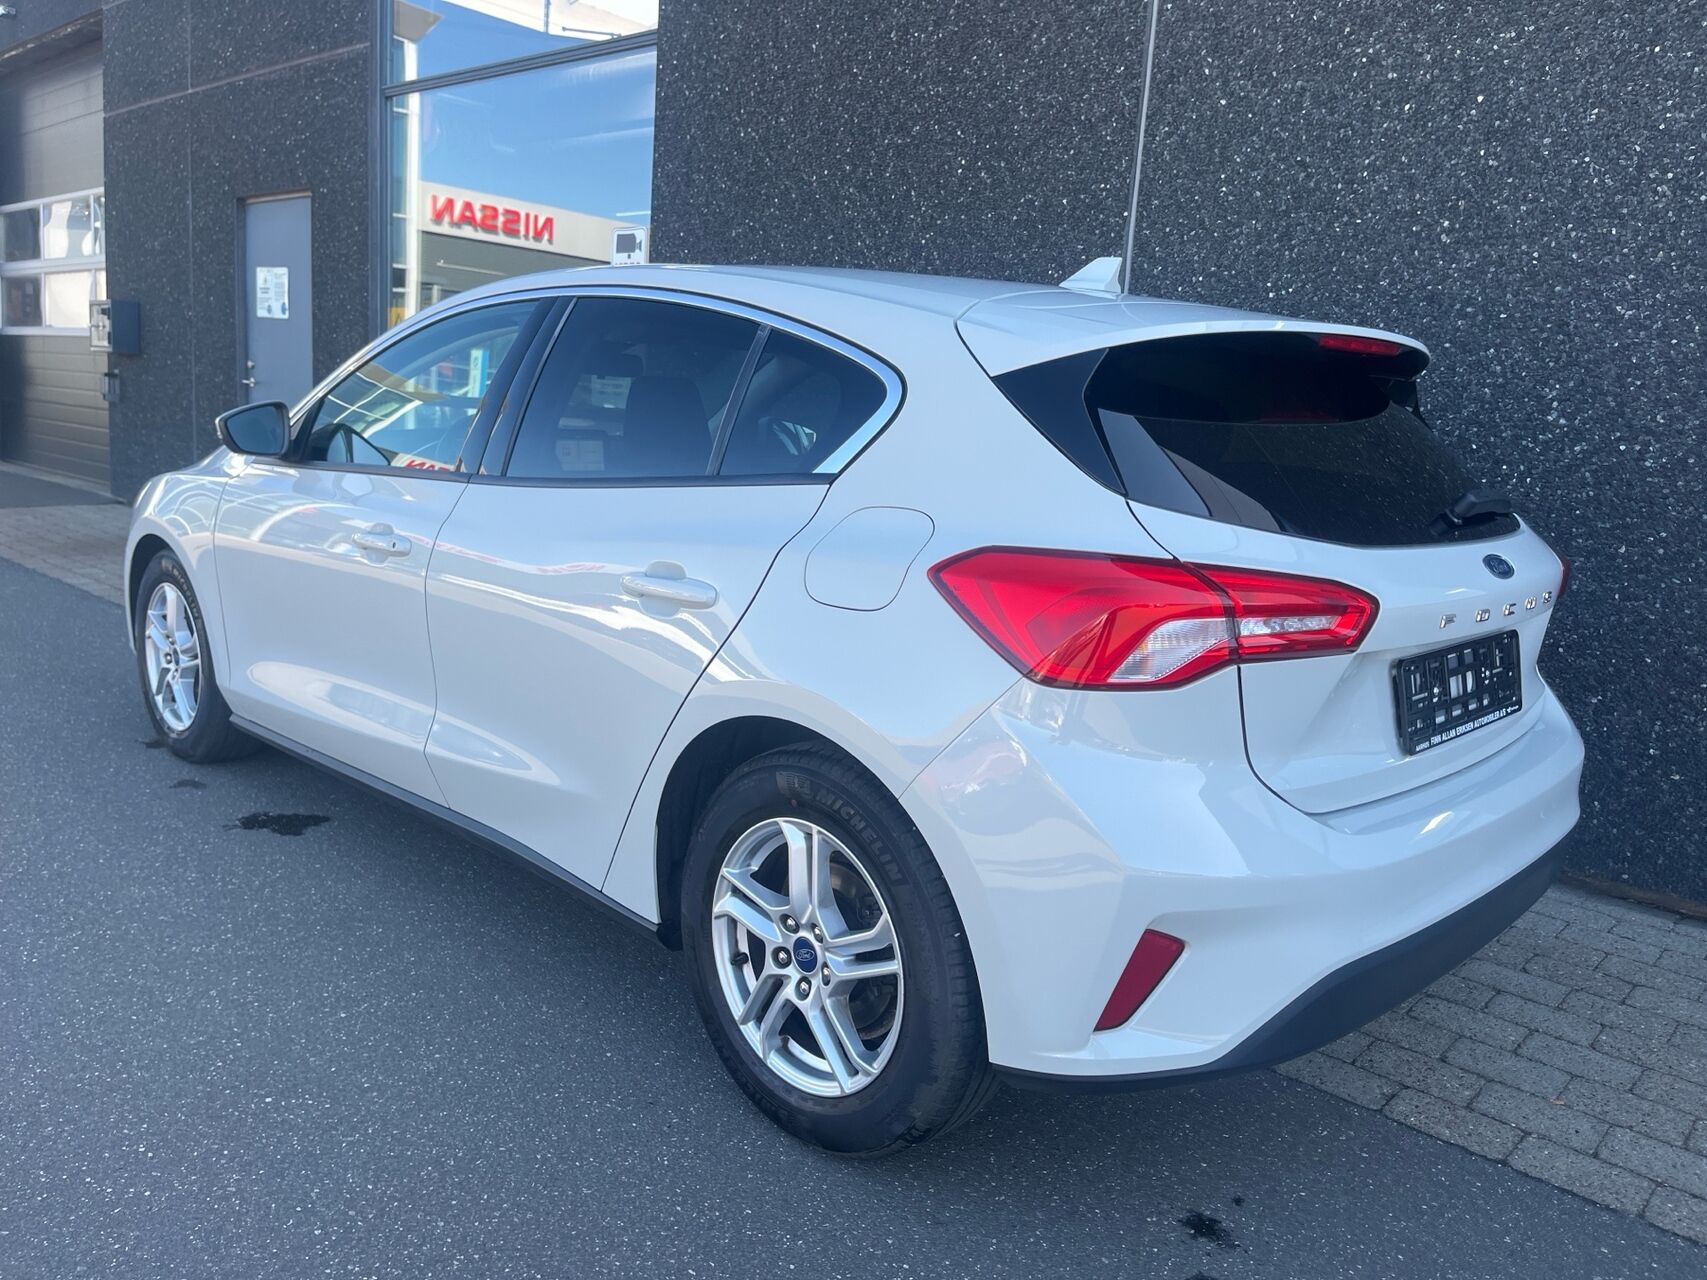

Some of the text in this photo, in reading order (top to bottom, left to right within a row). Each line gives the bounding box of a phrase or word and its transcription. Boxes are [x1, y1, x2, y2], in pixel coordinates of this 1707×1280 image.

[1440, 591, 1552, 629] FOCUS
[1430, 734, 1441, 746] FINN
[1442, 728, 1456, 741] ALLAN
[1456, 721, 1474, 736] ERIKSEN
[1474, 711, 1499, 728] AUTOMOBILER
[816, 791, 903, 882] MICHELIN
